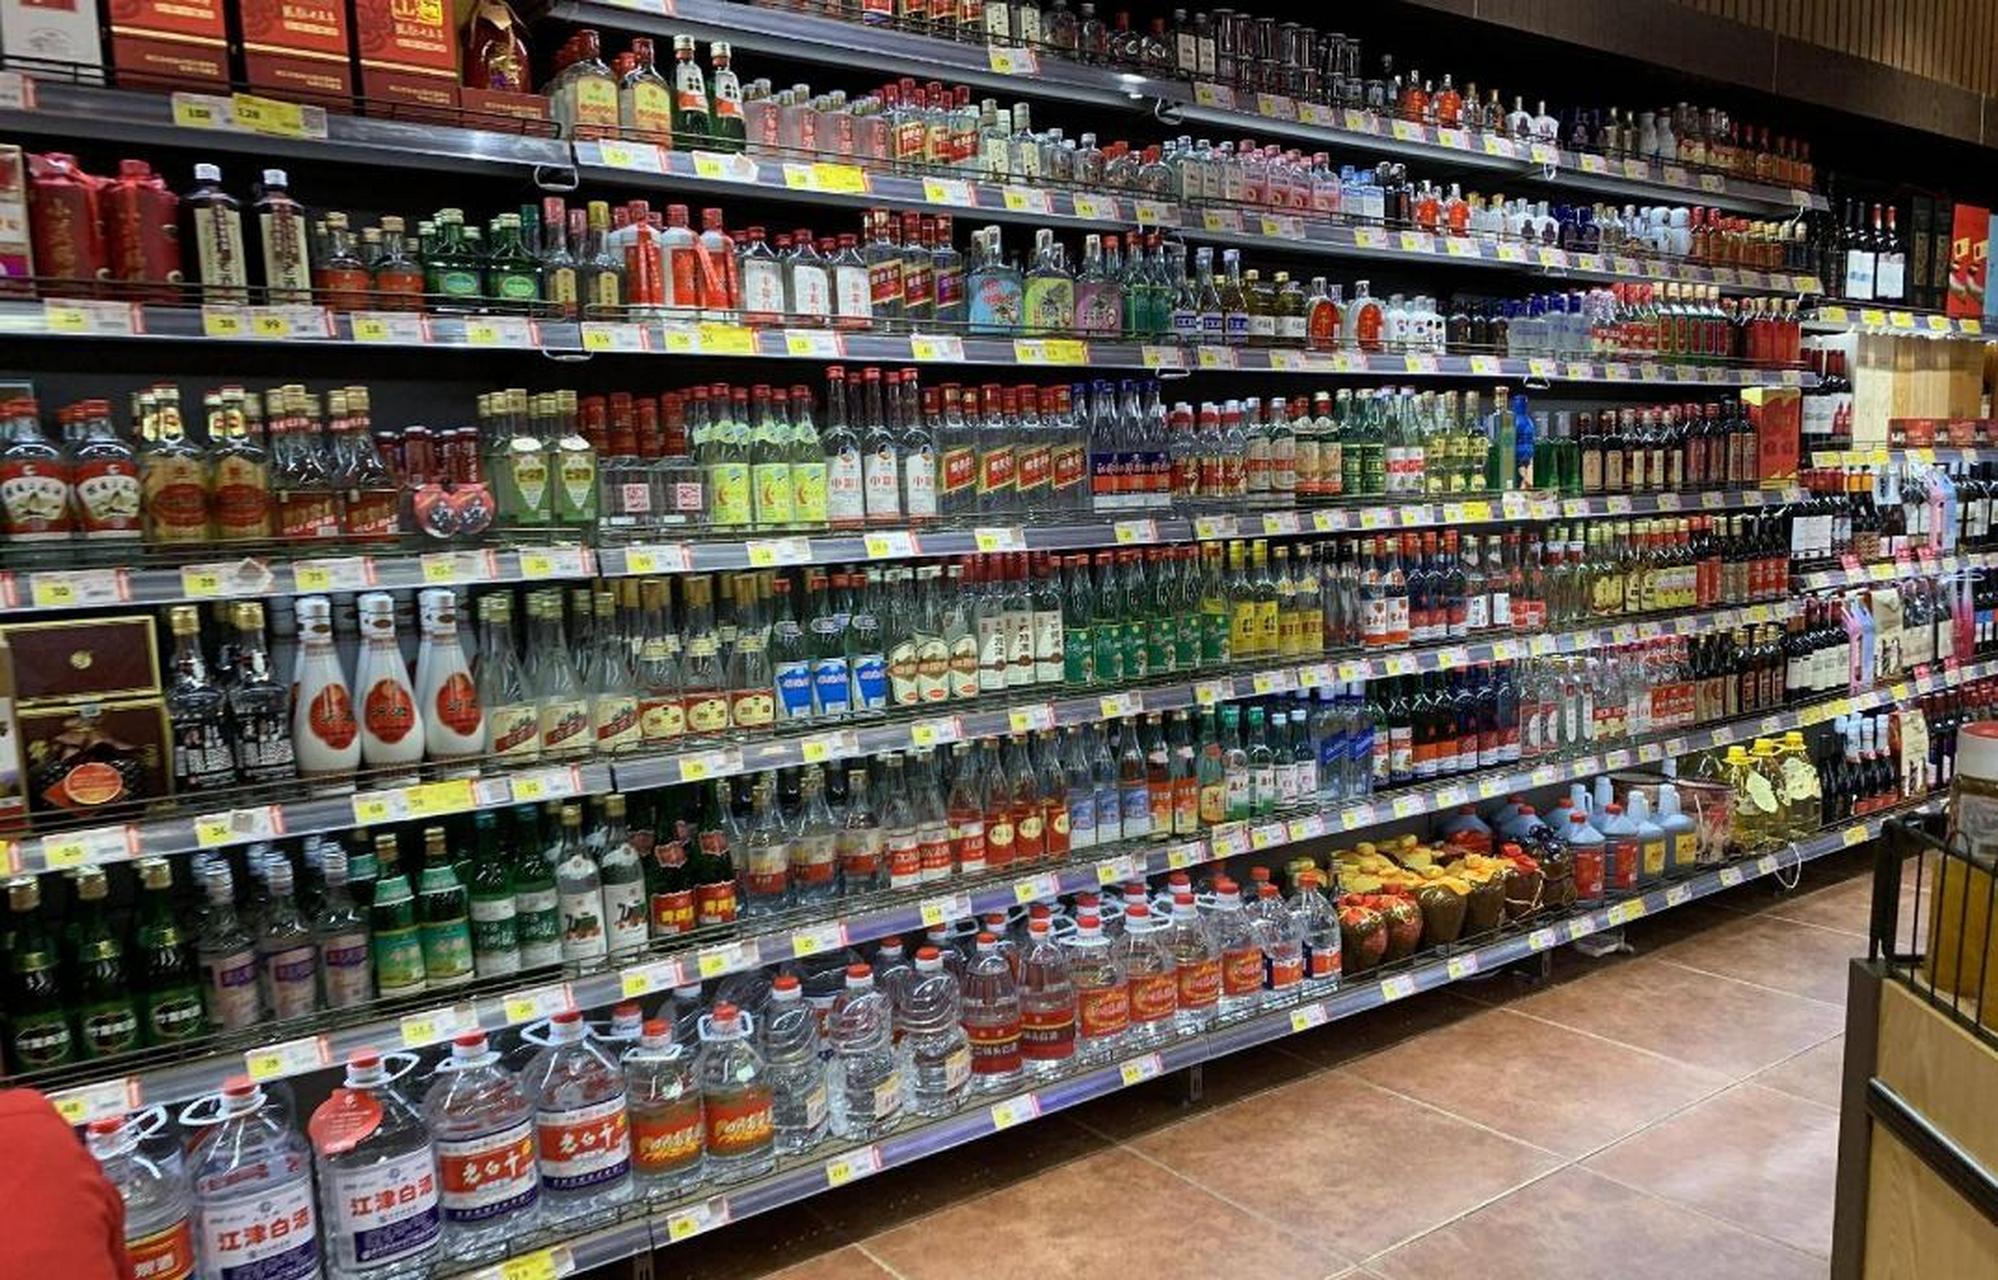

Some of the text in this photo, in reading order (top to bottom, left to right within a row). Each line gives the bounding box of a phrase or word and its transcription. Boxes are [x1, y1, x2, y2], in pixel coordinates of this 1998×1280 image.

[462, 1150, 519, 1185] 老白干
[349, 1174, 434, 1218] 江津白酒
[217, 1205, 310, 1253] 江津白酒
